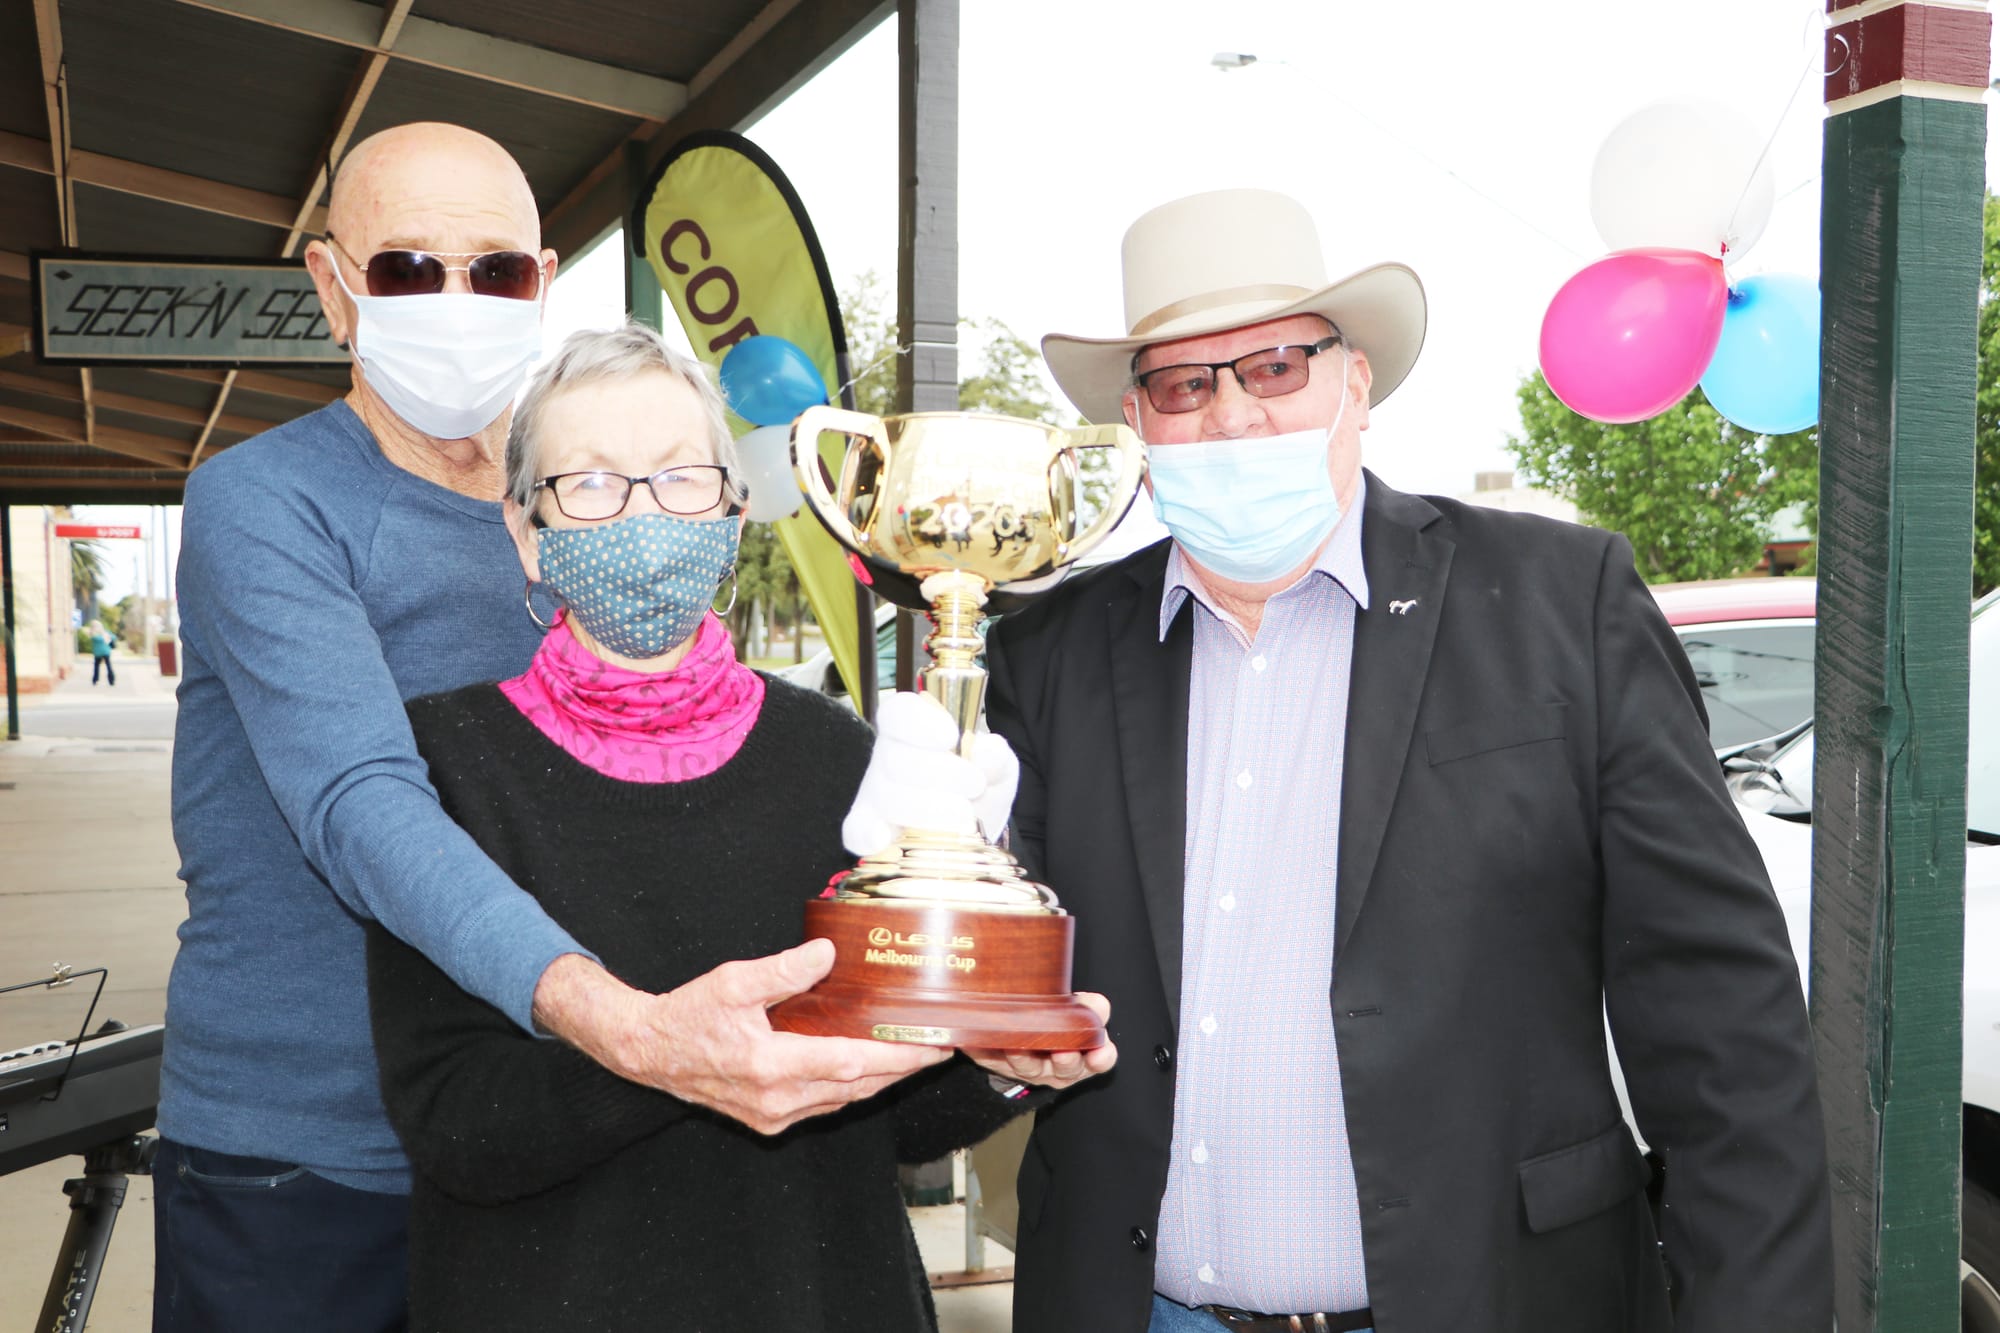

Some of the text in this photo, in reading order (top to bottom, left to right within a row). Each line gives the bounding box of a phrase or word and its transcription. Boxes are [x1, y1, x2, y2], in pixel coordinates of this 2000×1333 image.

[660, 218, 763, 353] COF
[917, 501, 1017, 537] 2020
[894, 932, 975, 949] LEUS
[945, 954, 976, 973] Cup
